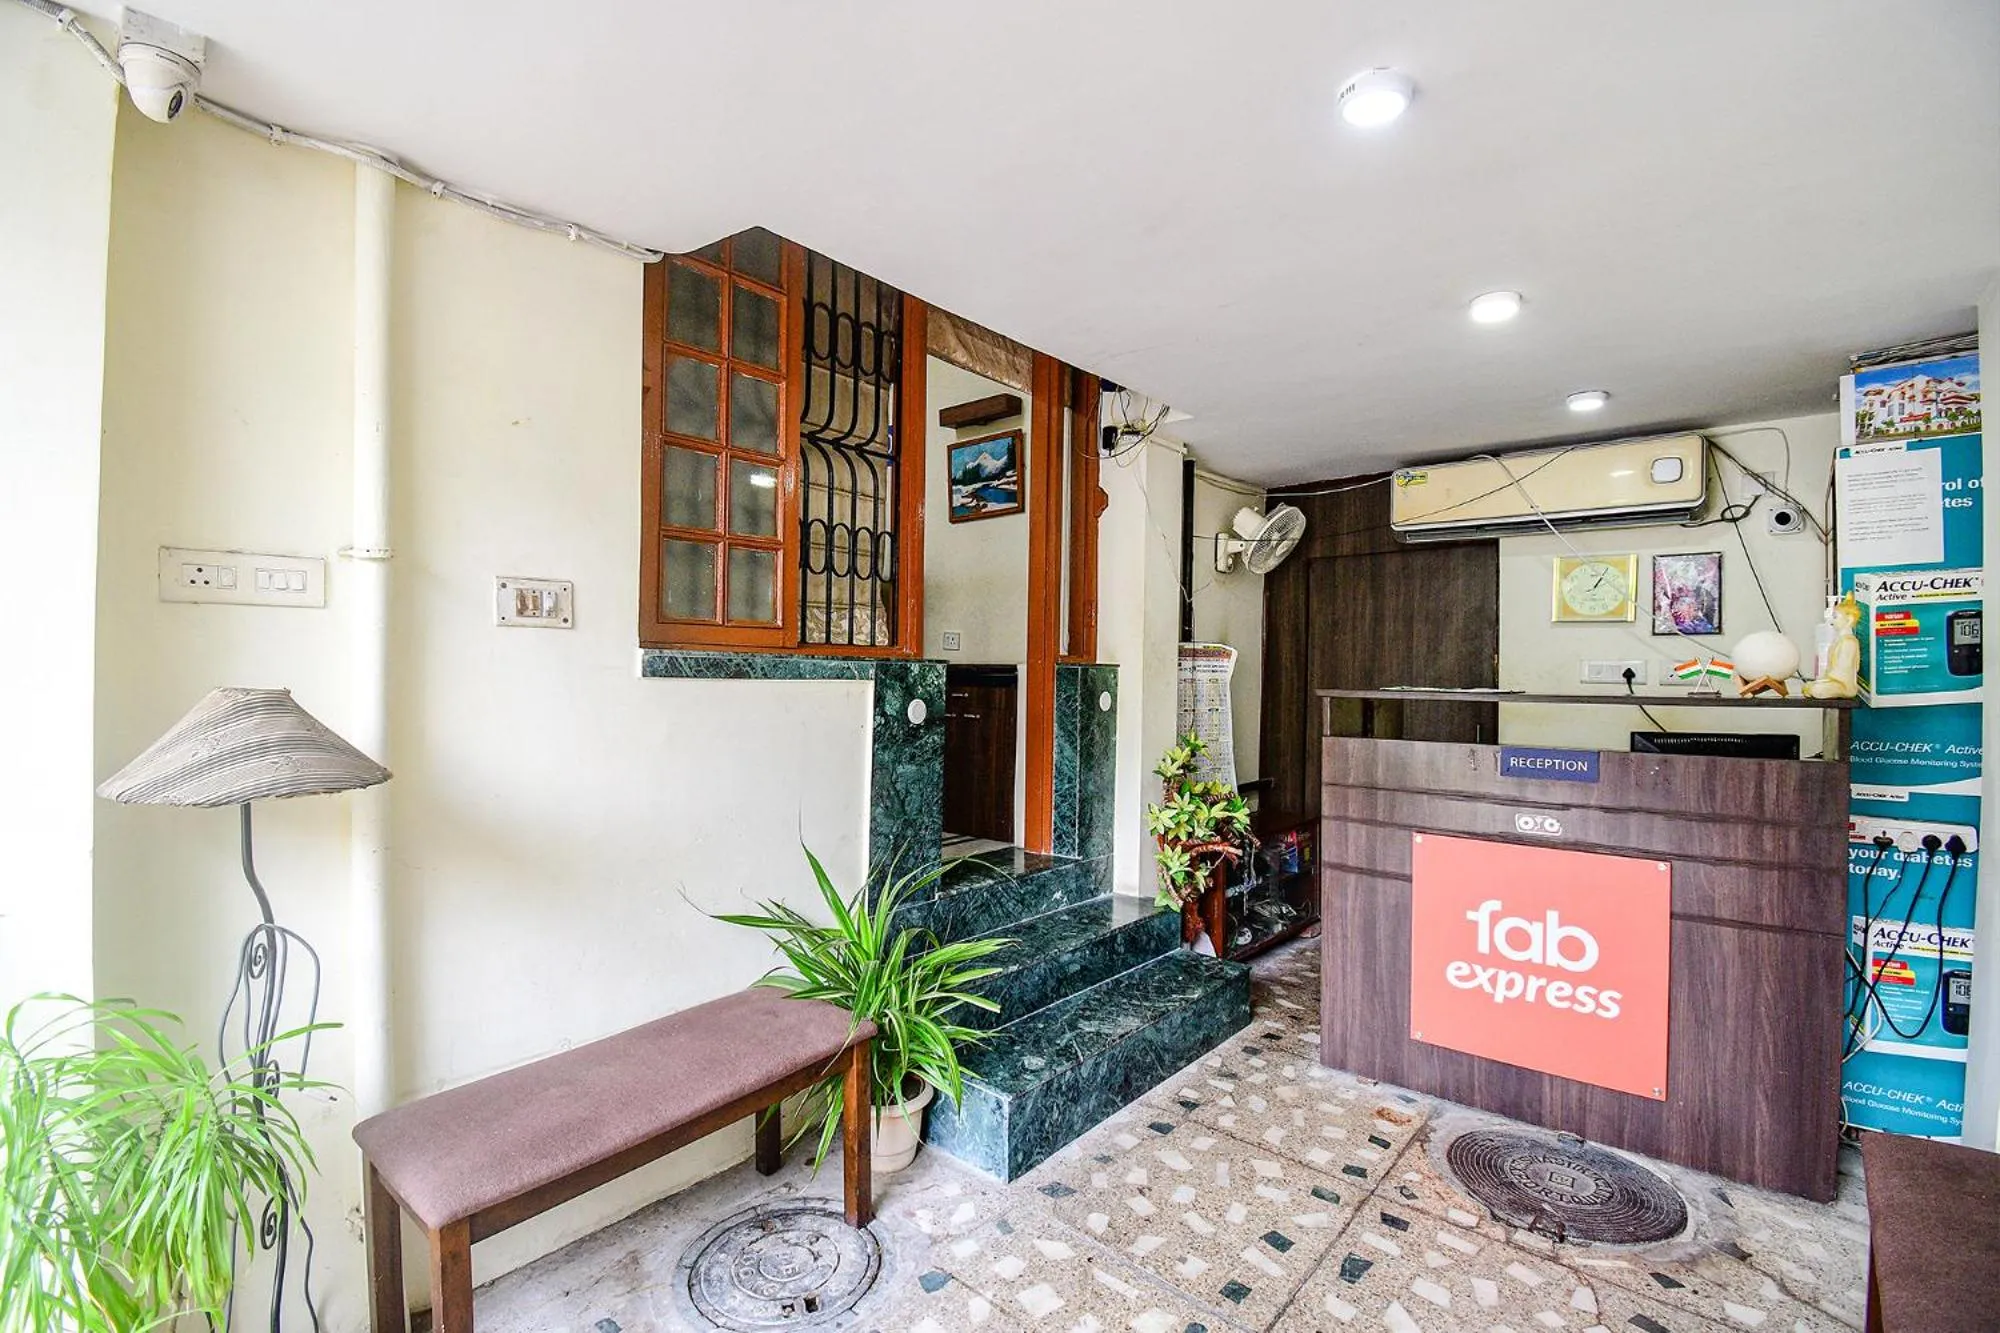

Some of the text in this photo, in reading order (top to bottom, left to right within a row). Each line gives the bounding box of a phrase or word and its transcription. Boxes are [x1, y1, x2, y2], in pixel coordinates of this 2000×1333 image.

[1876, 577, 1974, 593] ACCU-CHEK
[1876, 593, 1908, 601] Active
[1850, 741, 1933, 754] ACCU-CHEK
[1510, 757, 1588, 771] RECEPTION
[1875, 757, 1909, 765] Glucose
[1910, 758, 1958, 769] Monitoring
[1848, 848, 1973, 868] your dabetes
[1466, 899, 1600, 973] fab
[1874, 926, 1970, 949] ACCU-CHEK
[1446, 961, 1623, 1019] express
[1843, 1081, 1925, 1105] ACCU-CHEK
[1867, 1099, 1901, 1113] Glucose
[1902, 1105, 1949, 1124] Monitoring
